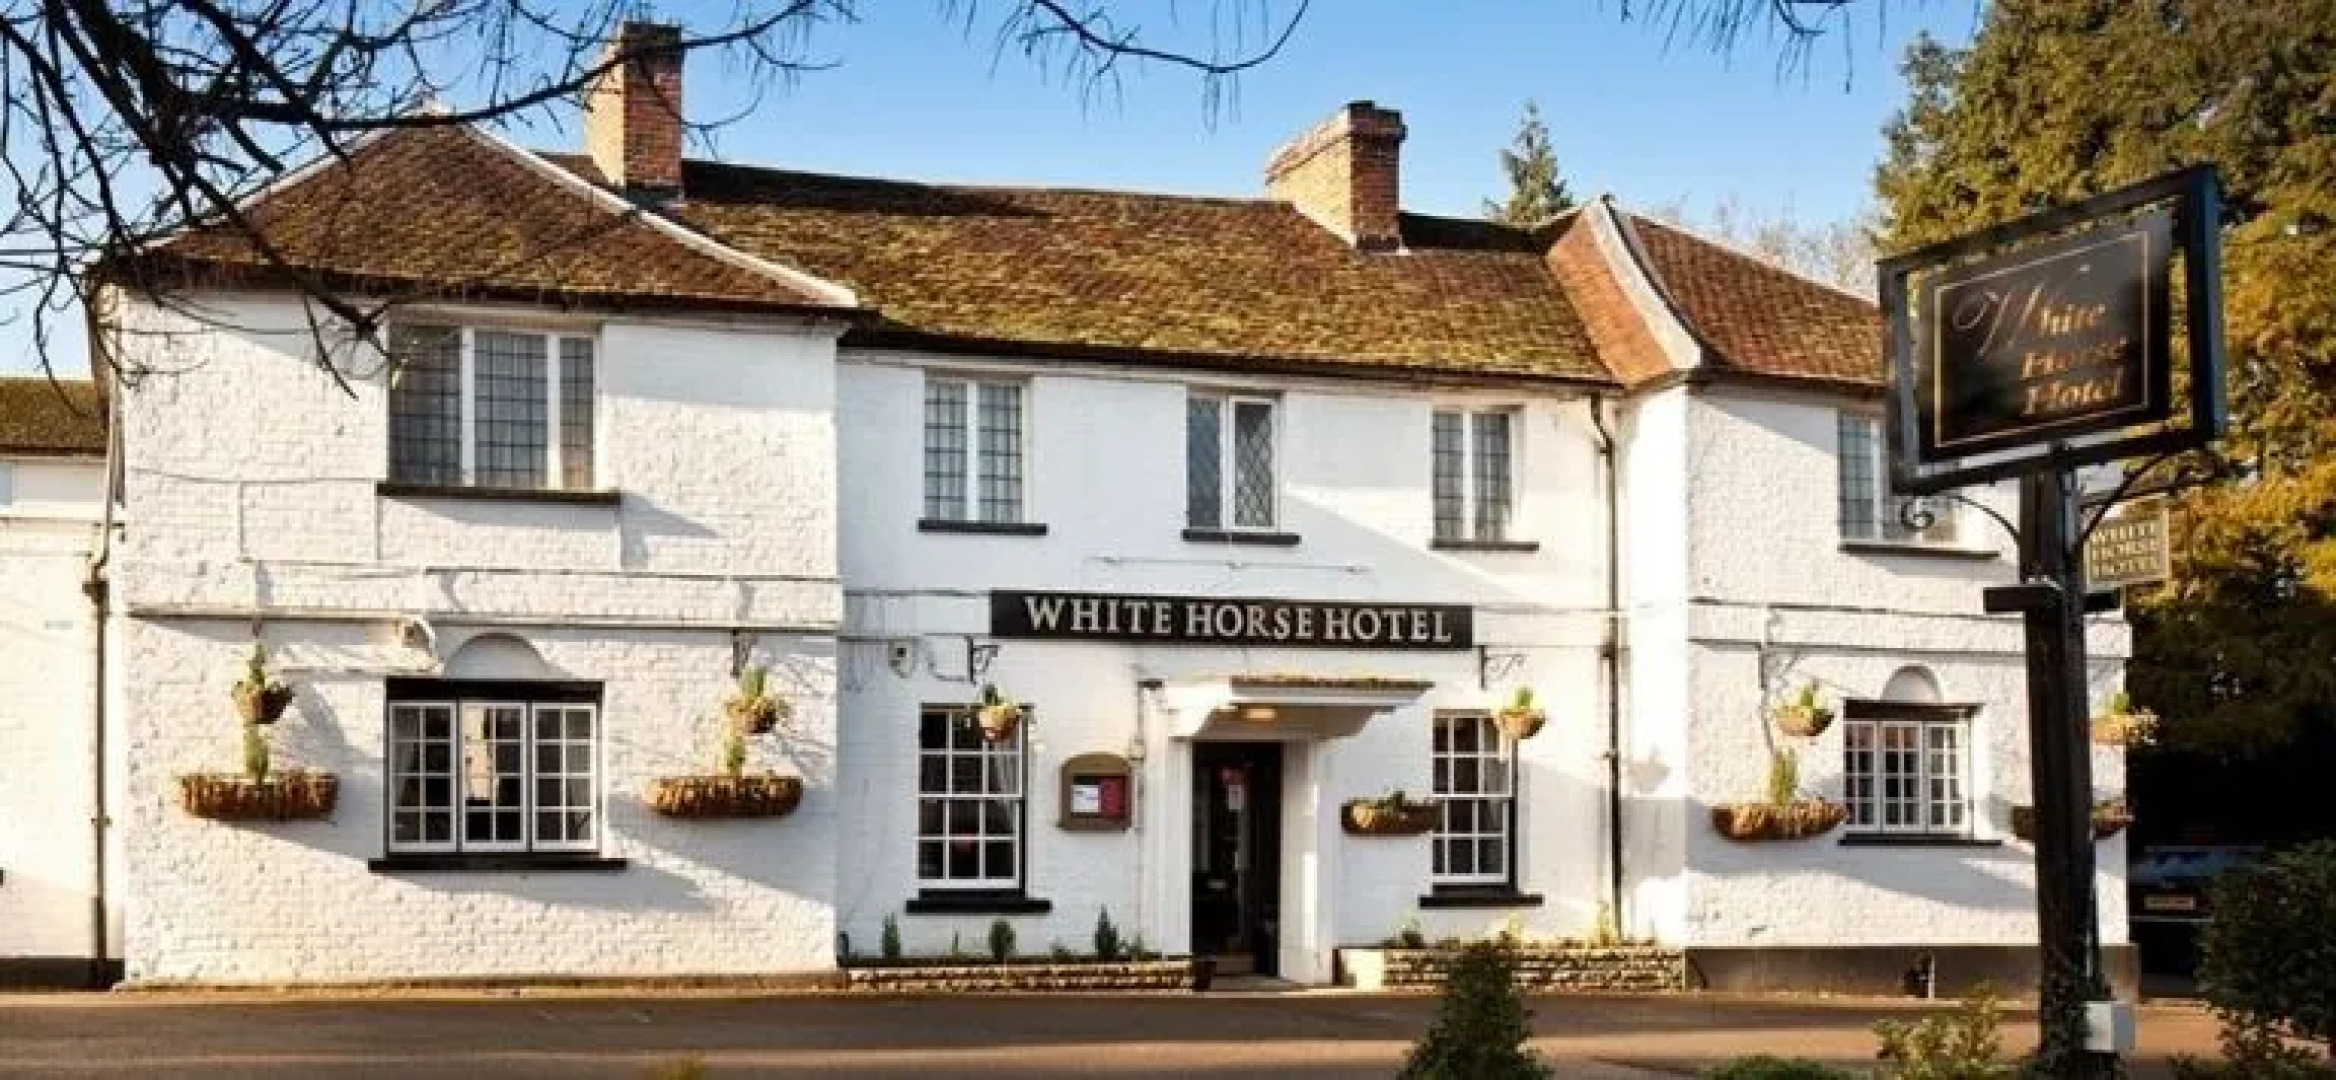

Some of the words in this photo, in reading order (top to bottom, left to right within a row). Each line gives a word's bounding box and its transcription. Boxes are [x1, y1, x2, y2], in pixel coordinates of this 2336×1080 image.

[1952, 281, 2106, 358] White
[2020, 366, 2125, 415] Hotel
[2090, 523, 2157, 545] WHITE
[2092, 538, 2160, 561] HORSE
[2091, 556, 2160, 579] HOTEL
[1024, 596, 1172, 634] WHITE
[1185, 602, 1314, 640] HORSE
[1323, 607, 1452, 643] HOTEL
